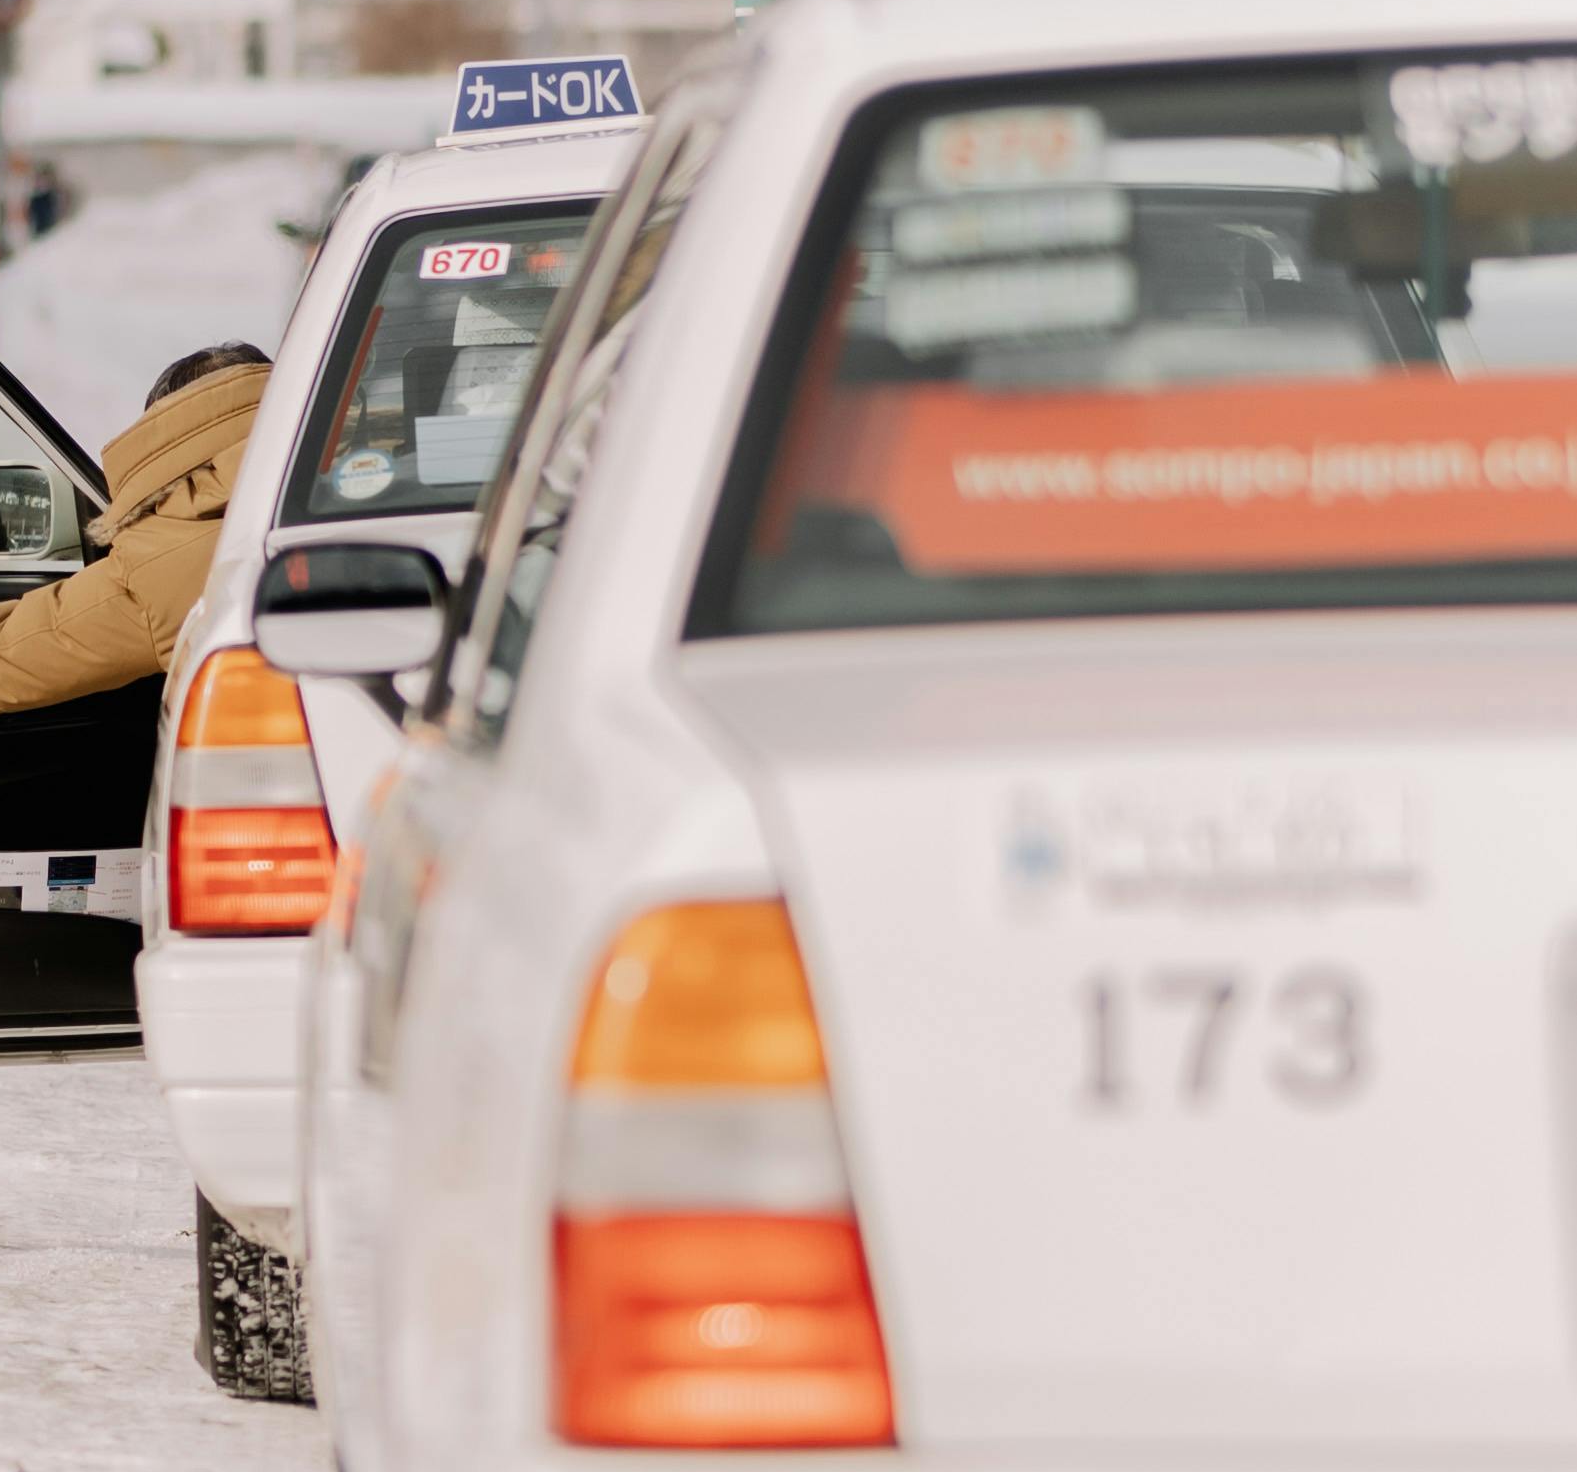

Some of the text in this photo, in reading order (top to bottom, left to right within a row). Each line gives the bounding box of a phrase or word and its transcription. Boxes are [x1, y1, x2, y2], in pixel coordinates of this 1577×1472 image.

[466, 67, 624, 119] カードOK
[430, 247, 501, 275] 670
[1076, 961, 1374, 1115] 173
